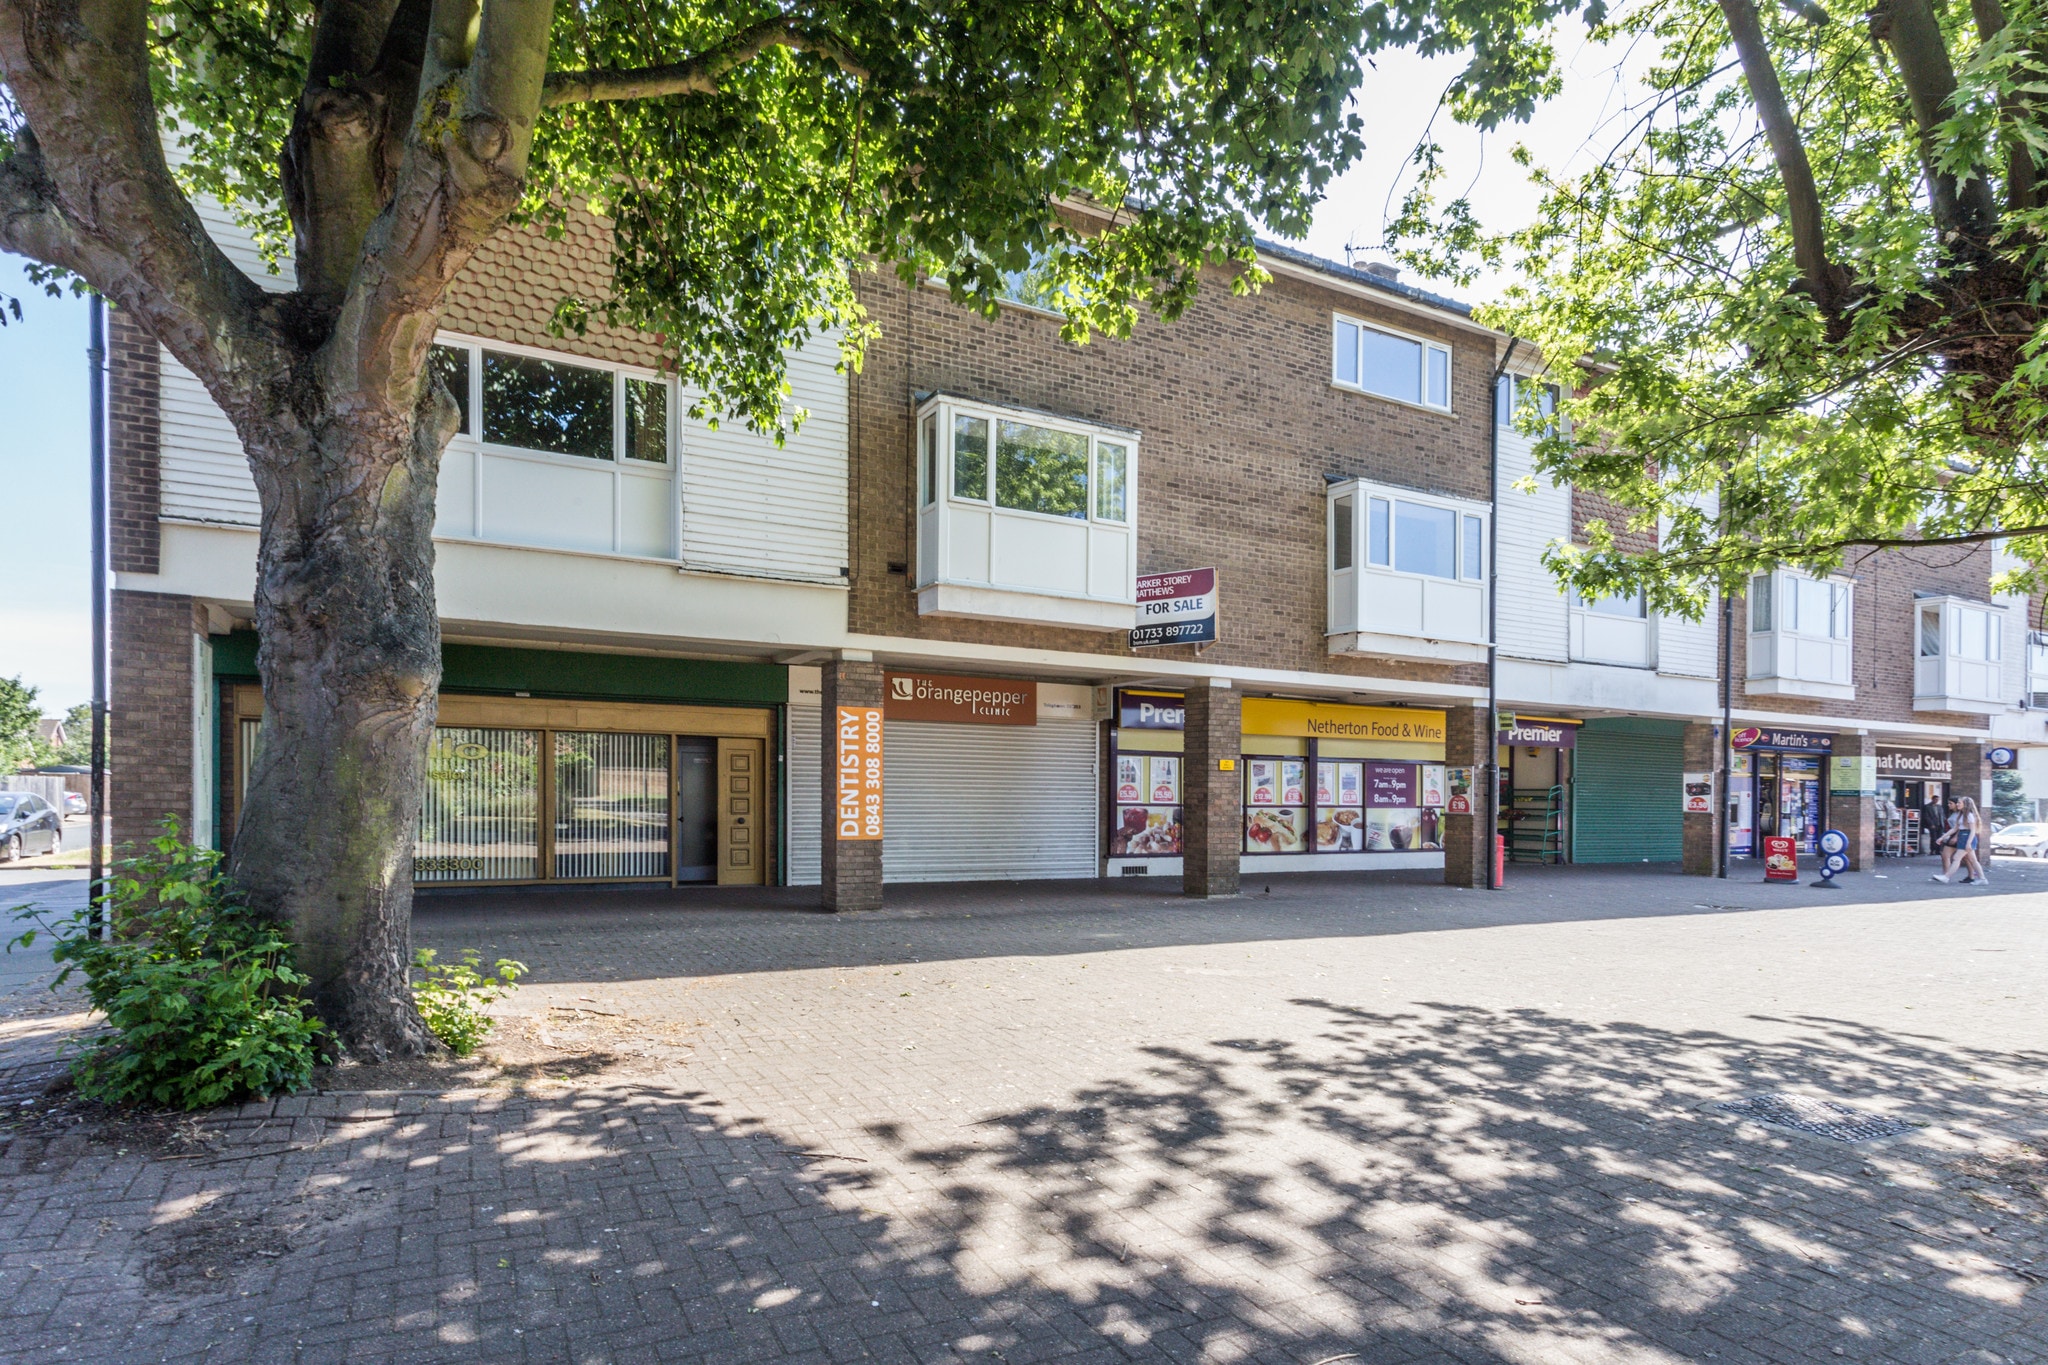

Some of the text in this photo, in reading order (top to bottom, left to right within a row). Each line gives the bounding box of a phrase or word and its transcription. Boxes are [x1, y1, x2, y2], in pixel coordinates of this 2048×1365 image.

[1136, 575, 1192, 589] ARKER STOREY
[1145, 598, 1203, 615] FOR SALE
[1132, 623, 1204, 640] 01733 897722
[916, 679, 933, 687] THE
[916, 686, 1028, 713] orangepepper
[979, 707, 1010, 716] CLINIC
[1140, 703, 1185, 723] Pre
[1307, 718, 1442, 739] Netherton Food & Wine
[1508, 728, 1562, 742] Premier
[1771, 732, 1808, 747] Martin's
[1391, 767, 1405, 775] open
[1895, 754, 1922, 770] Food
[1925, 755, 1952, 771] Store
[840, 710, 859, 837] DENTISTRY
[865, 711, 880, 836] 0843 308 8000
[1452, 801, 1465, 810] £16
